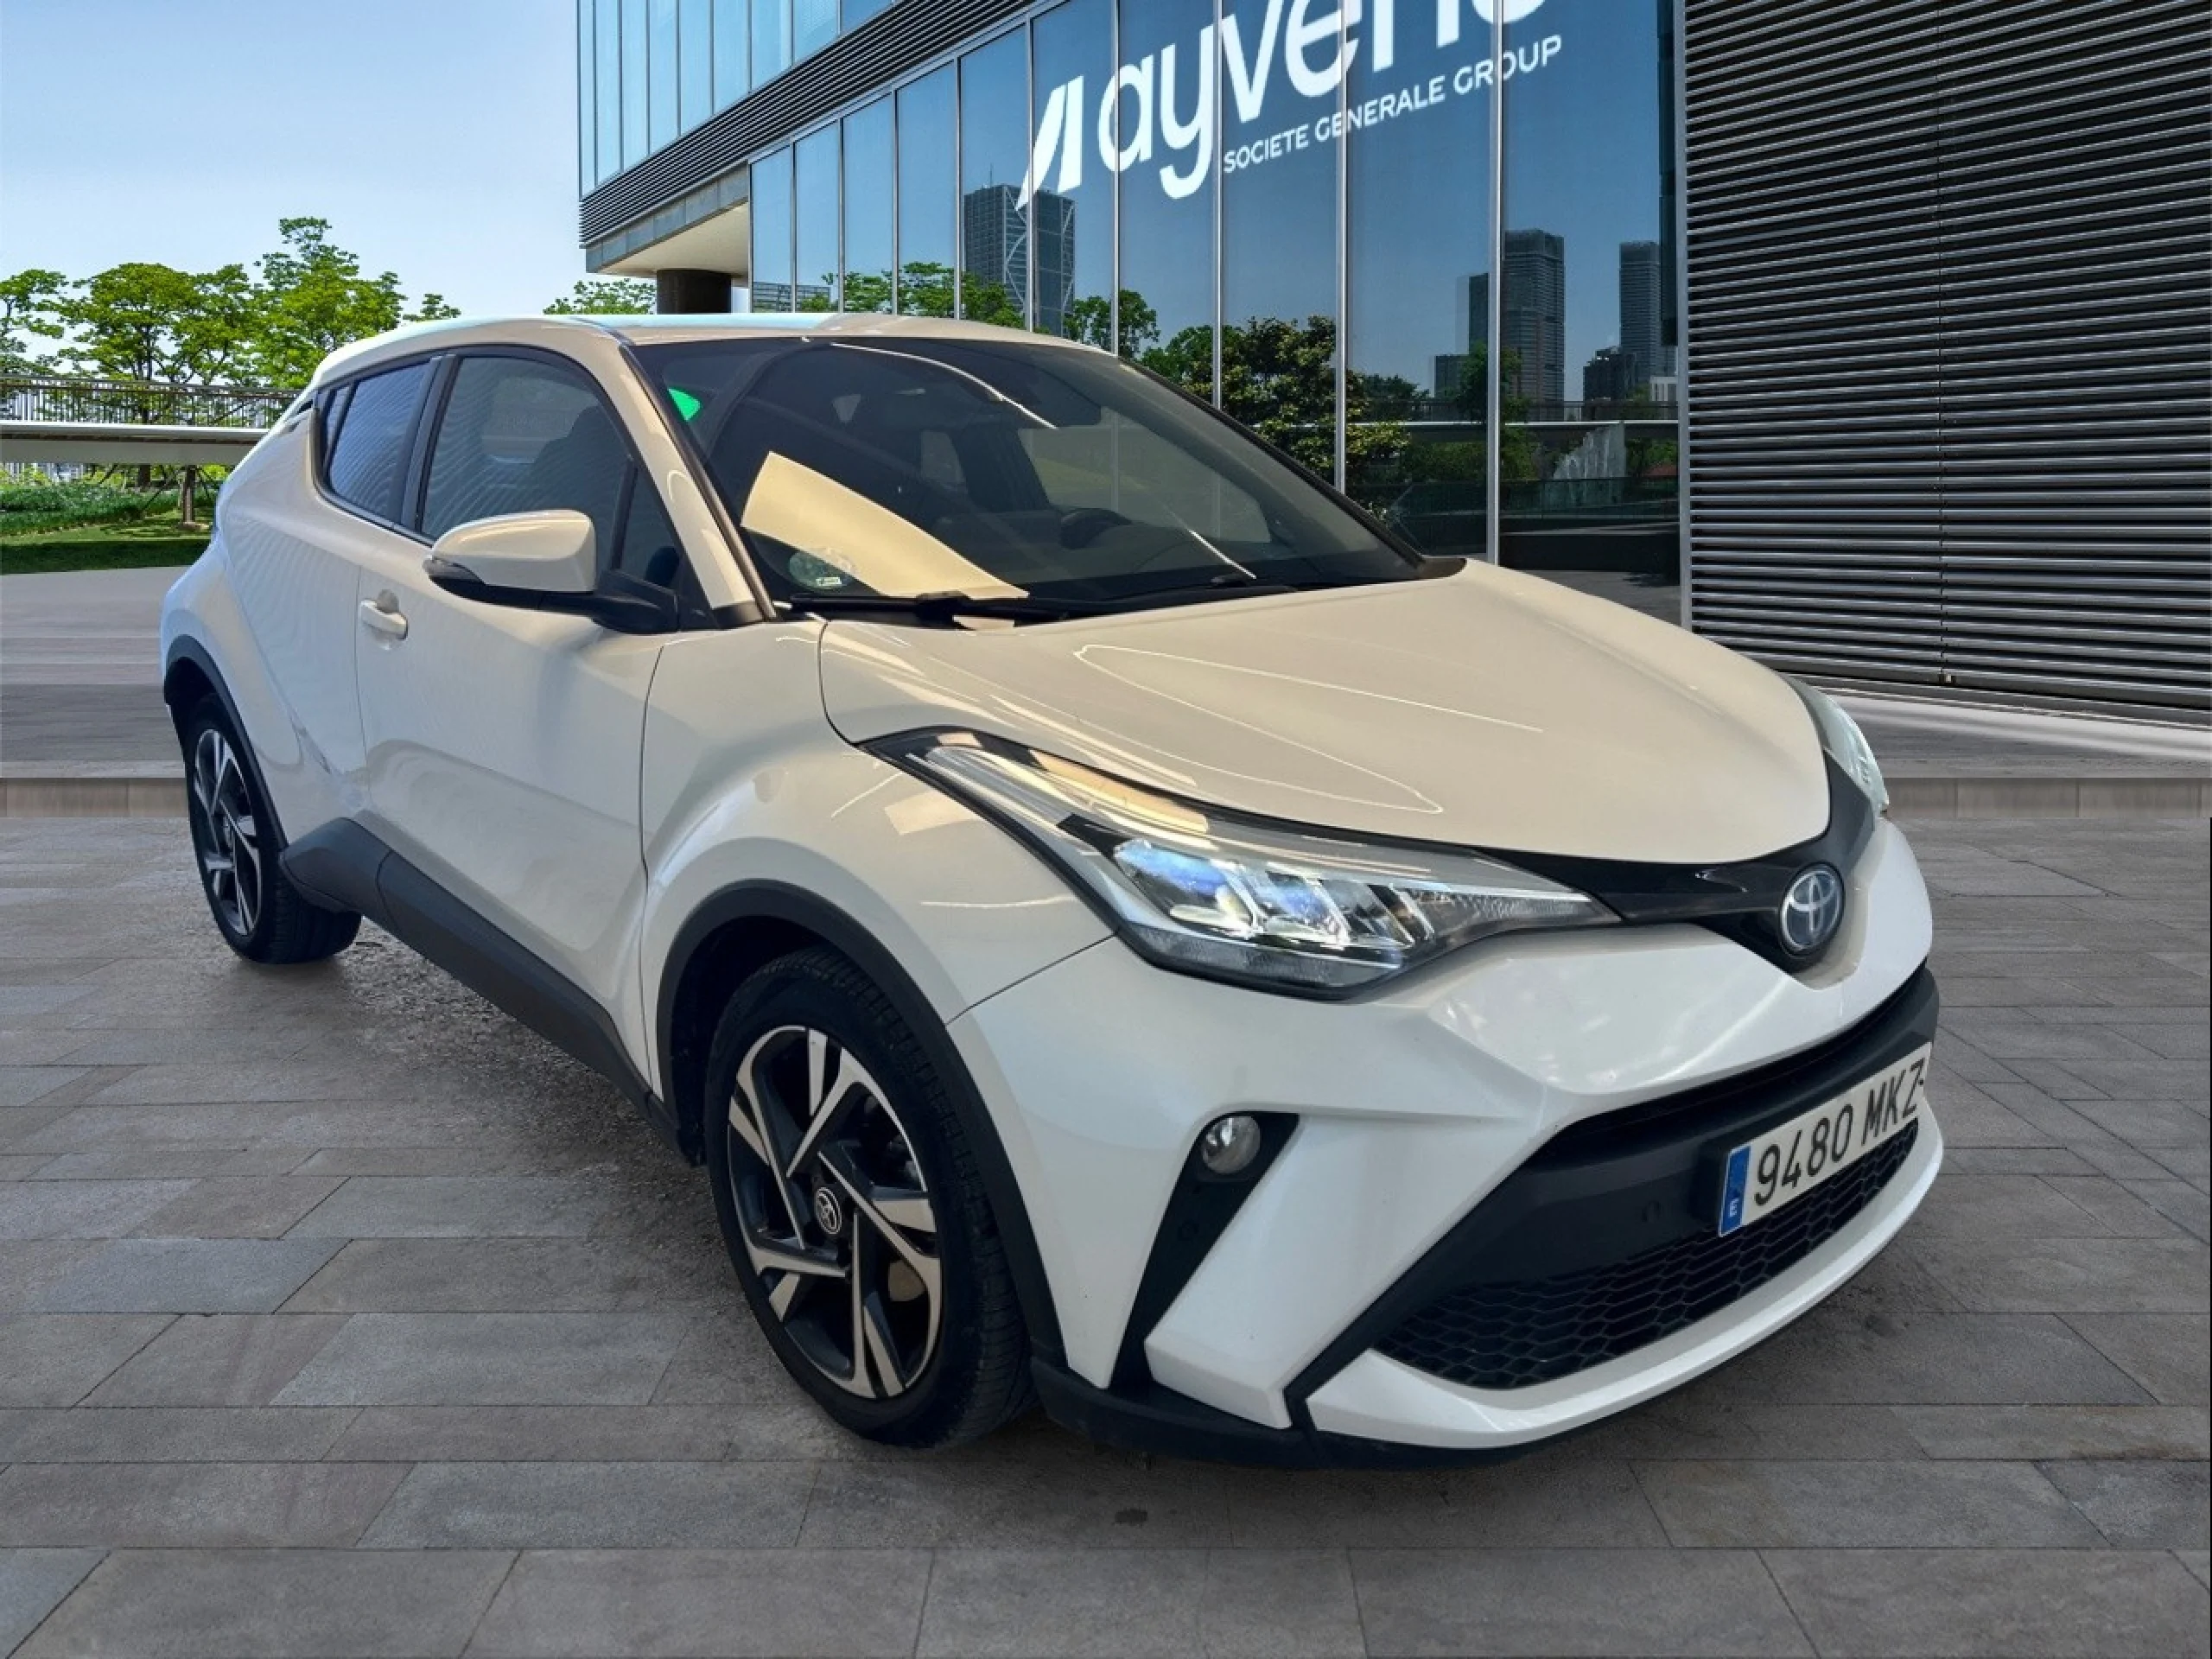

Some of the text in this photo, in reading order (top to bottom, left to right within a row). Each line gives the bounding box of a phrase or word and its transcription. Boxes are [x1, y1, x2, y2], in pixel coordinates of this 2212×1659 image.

[1223, 34, 1561, 174] SOCIETE GENERALE GROUP
[1728, 1058, 1925, 1217] E 9480 MKZ
